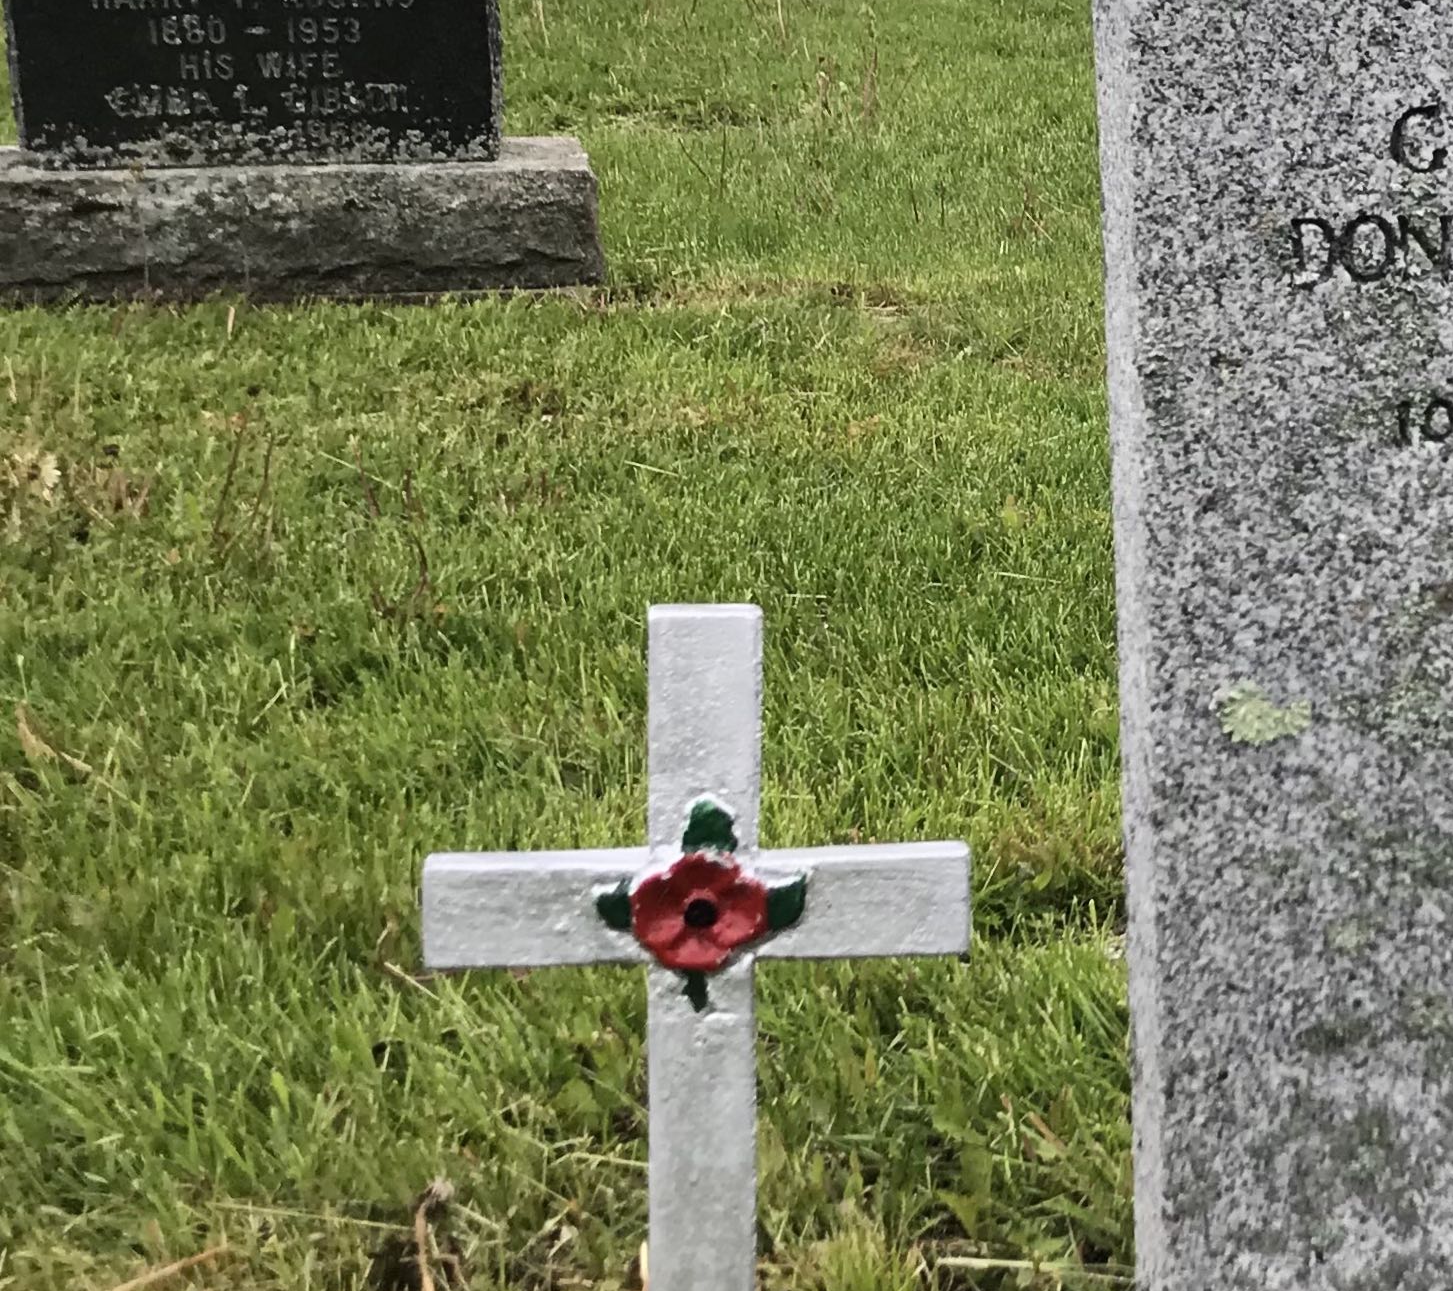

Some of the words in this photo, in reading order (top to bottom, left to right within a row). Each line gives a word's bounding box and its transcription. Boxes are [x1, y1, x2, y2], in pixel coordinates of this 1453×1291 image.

[287, 16, 362, 44] 1953
[180, 50, 234, 81] HIS
[256, 50, 343, 80] WIFE
